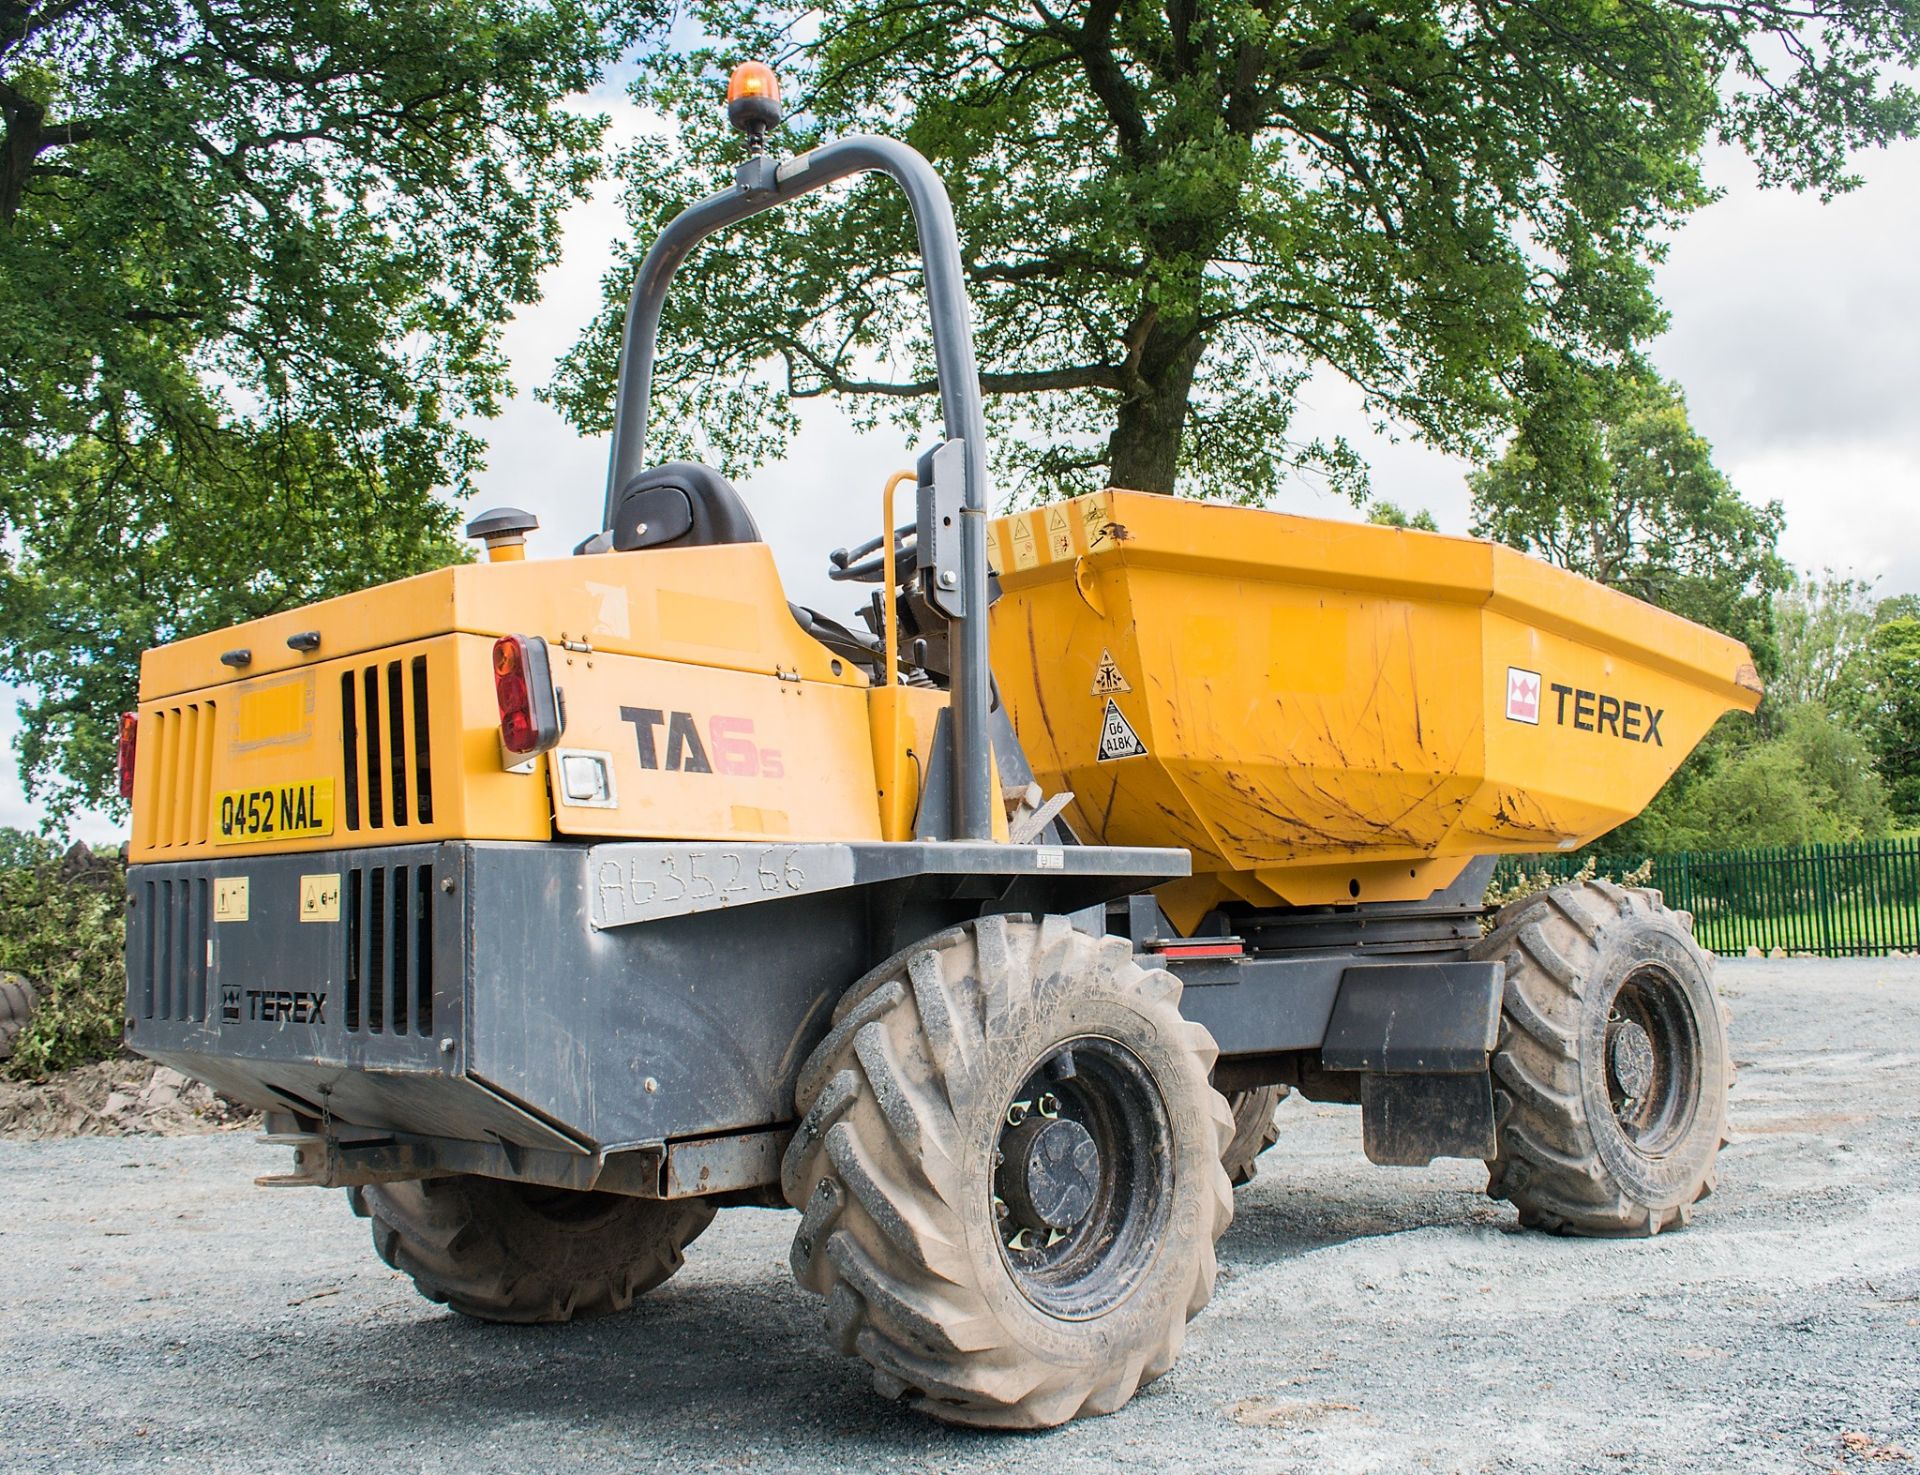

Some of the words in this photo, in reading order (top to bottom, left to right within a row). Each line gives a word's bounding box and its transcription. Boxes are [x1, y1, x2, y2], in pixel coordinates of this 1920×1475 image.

[1550, 682, 1665, 748] TEREX
[221, 790, 274, 836] Q452
[280, 784, 323, 831] NAL
[245, 989, 328, 1025] TEREX
